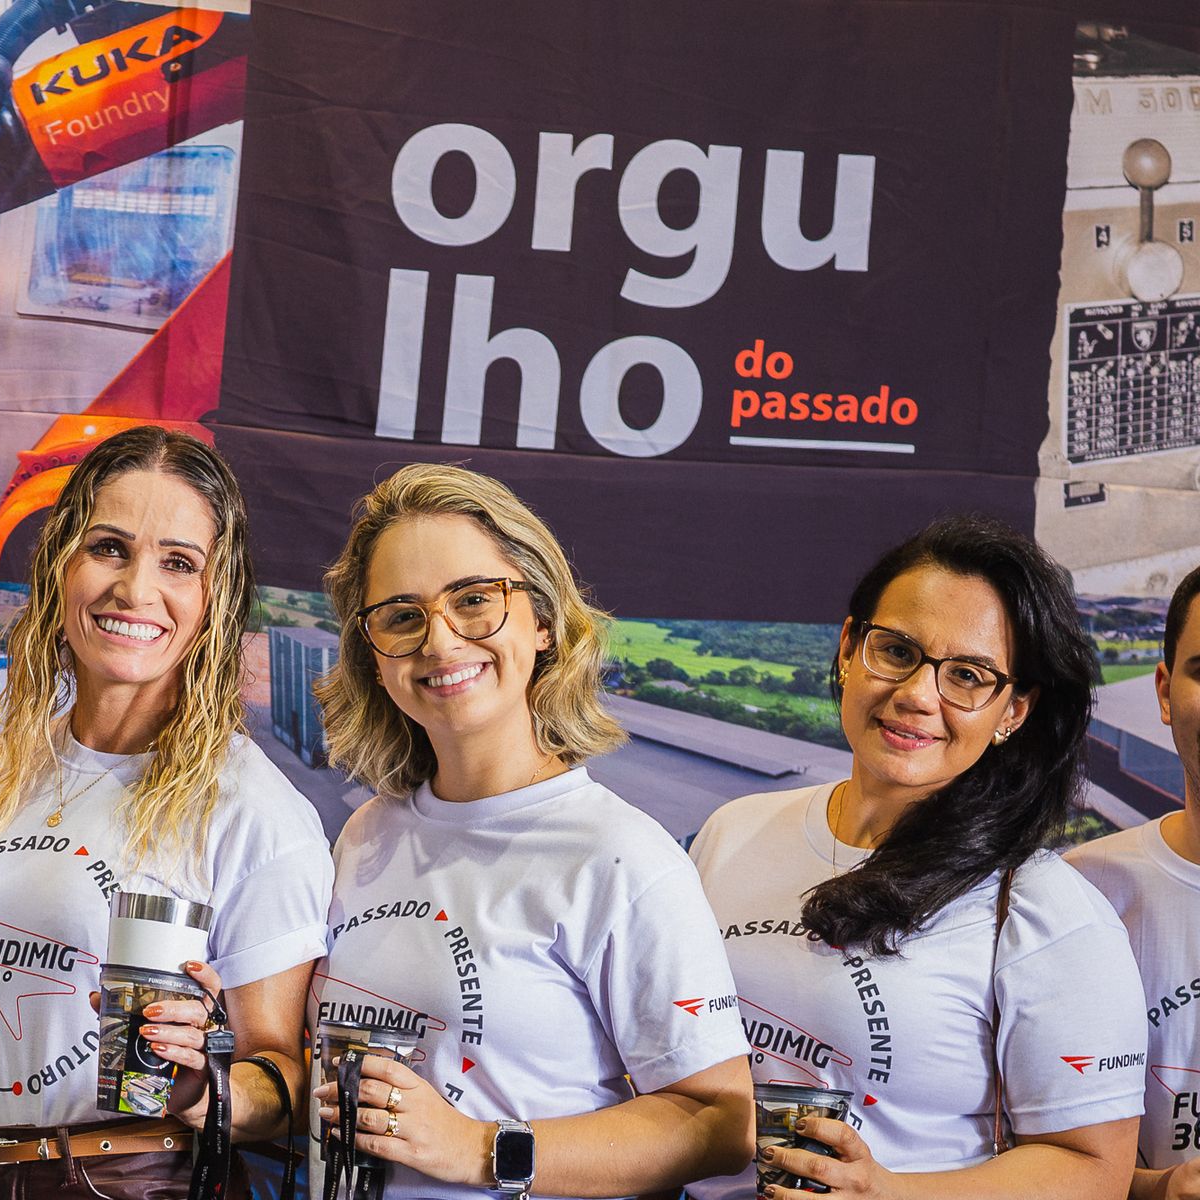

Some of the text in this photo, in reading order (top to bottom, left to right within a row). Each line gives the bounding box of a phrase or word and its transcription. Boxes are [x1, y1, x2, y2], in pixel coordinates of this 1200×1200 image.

[30, 24, 203, 106] KUKA
[43, 84, 172, 146] Foundry
[390, 122, 876, 308] orgu
[374, 268, 704, 458] lho
[734, 339, 794, 380] do
[730, 384, 919, 428] passado
[332, 899, 484, 1046] PASSADO PRESENTE
[719, 919, 892, 1084] ASSADO PRESENTE
[26, 1028, 100, 1096] UTURO
[741, 1016, 834, 1069] NDIMIG
[1098, 1051, 1146, 1072] FUNDIMIG
